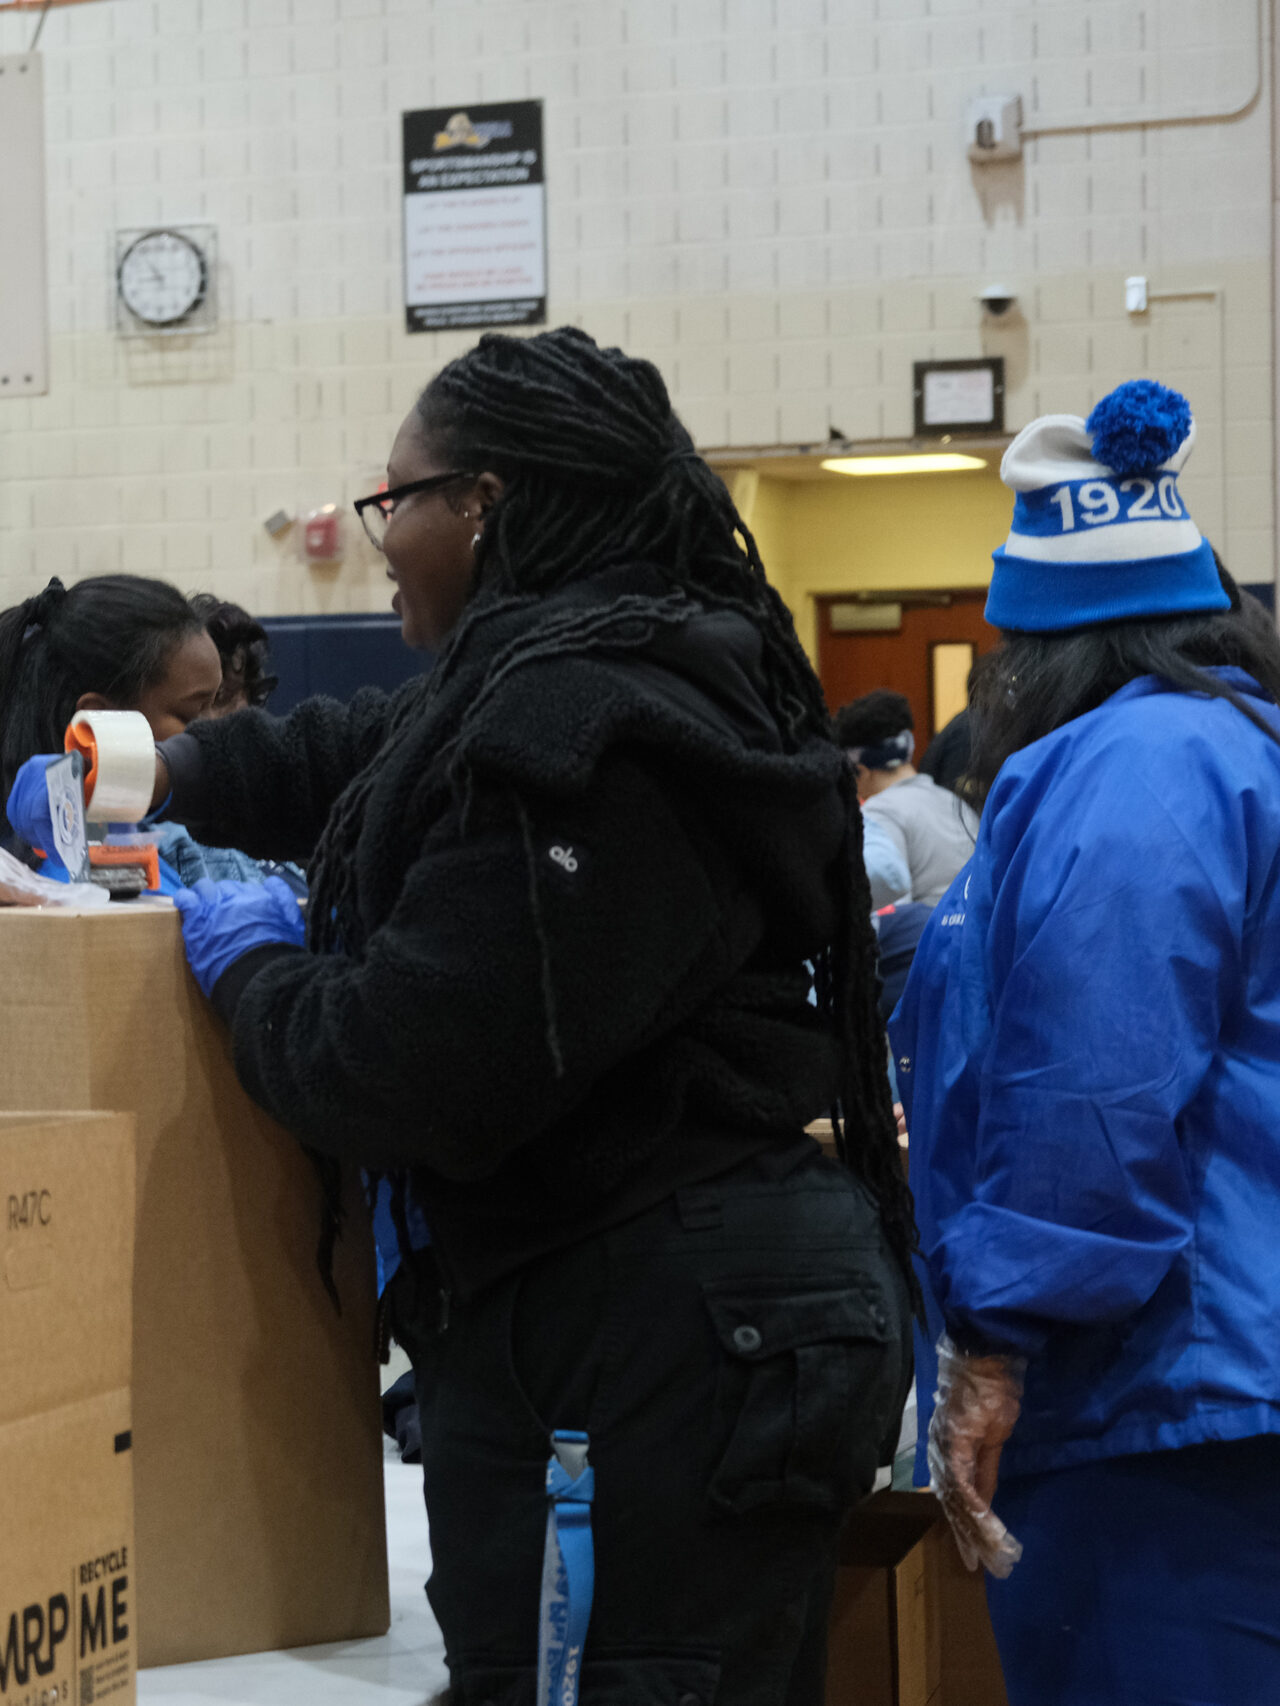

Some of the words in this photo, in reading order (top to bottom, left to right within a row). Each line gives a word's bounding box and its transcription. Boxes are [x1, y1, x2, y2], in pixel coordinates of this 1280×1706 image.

[1050, 475, 1182, 532] 1920
[7, 1188, 52, 1231] R47C
[80, 1546, 127, 1585] RECYCLE
[80, 1576, 129, 1659] ME
